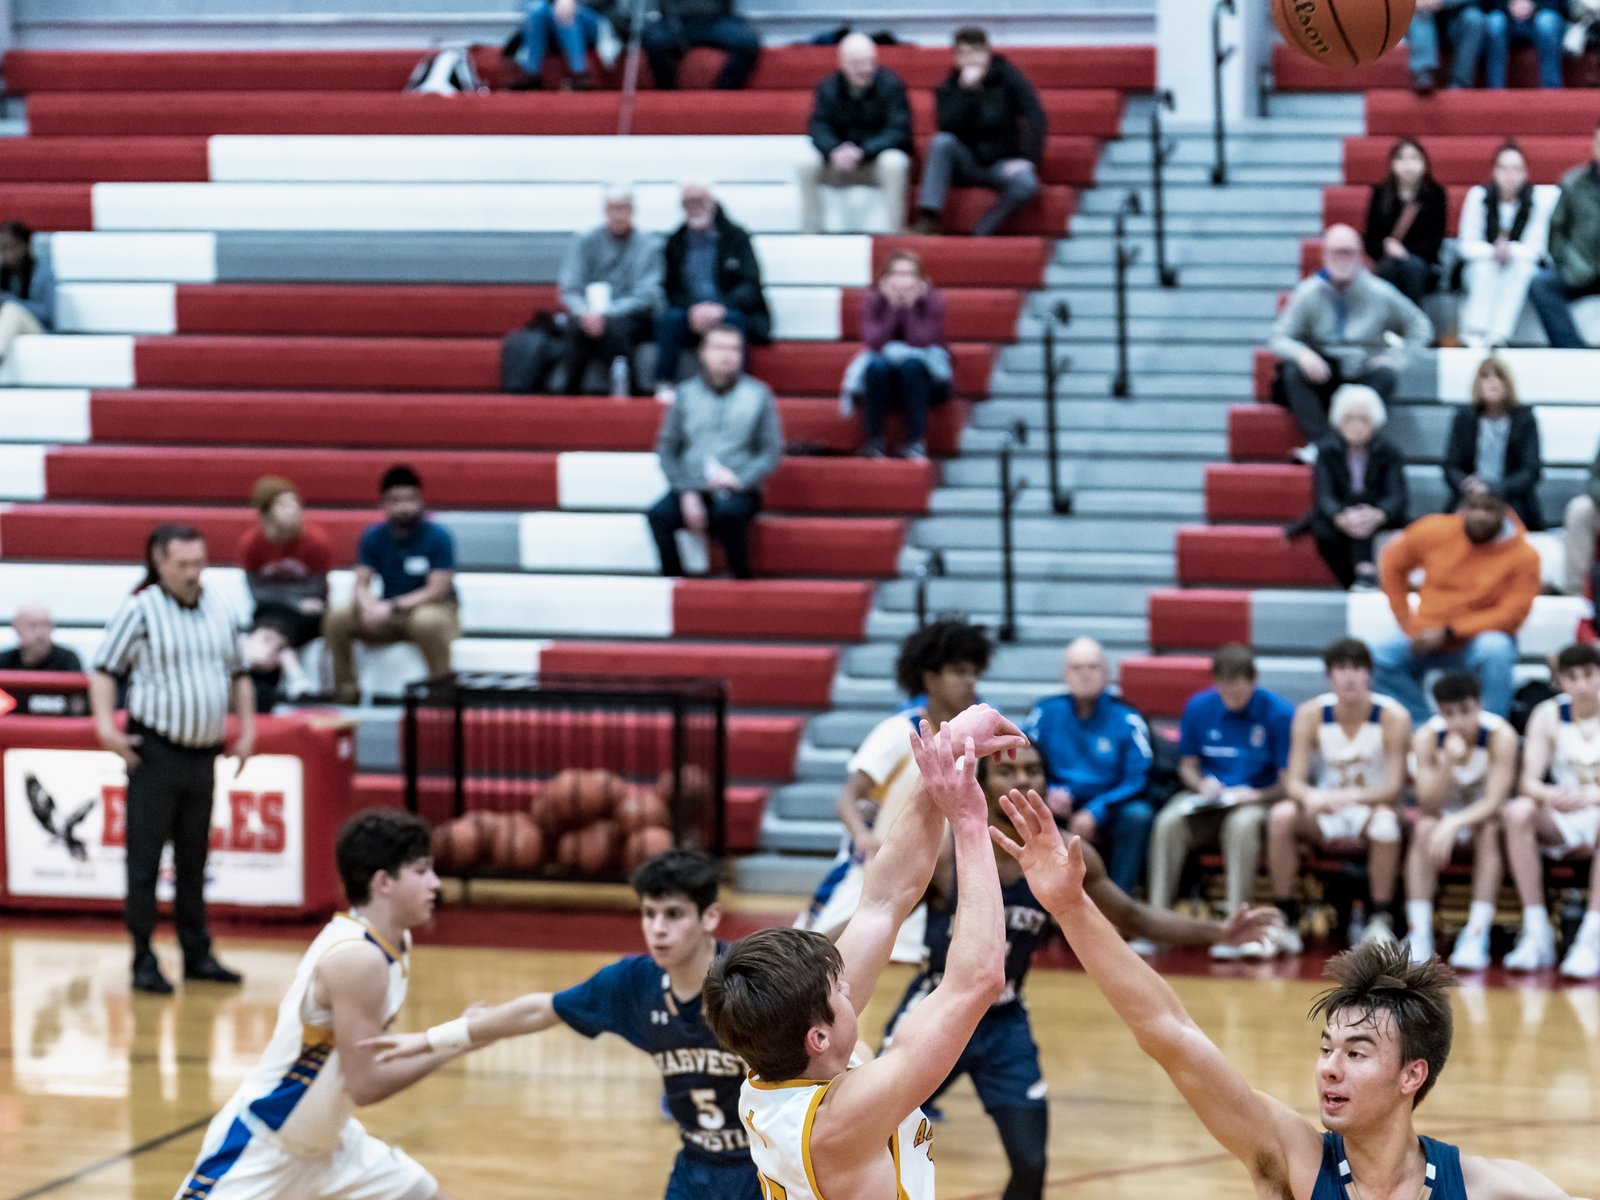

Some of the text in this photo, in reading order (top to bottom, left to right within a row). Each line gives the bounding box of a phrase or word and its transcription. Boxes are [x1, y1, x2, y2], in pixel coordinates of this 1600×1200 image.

[1292, 0, 1329, 52] lson
[102, 786, 286, 853] EES
[1004, 904, 1046, 935] EST
[690, 1088, 725, 1130] 5
